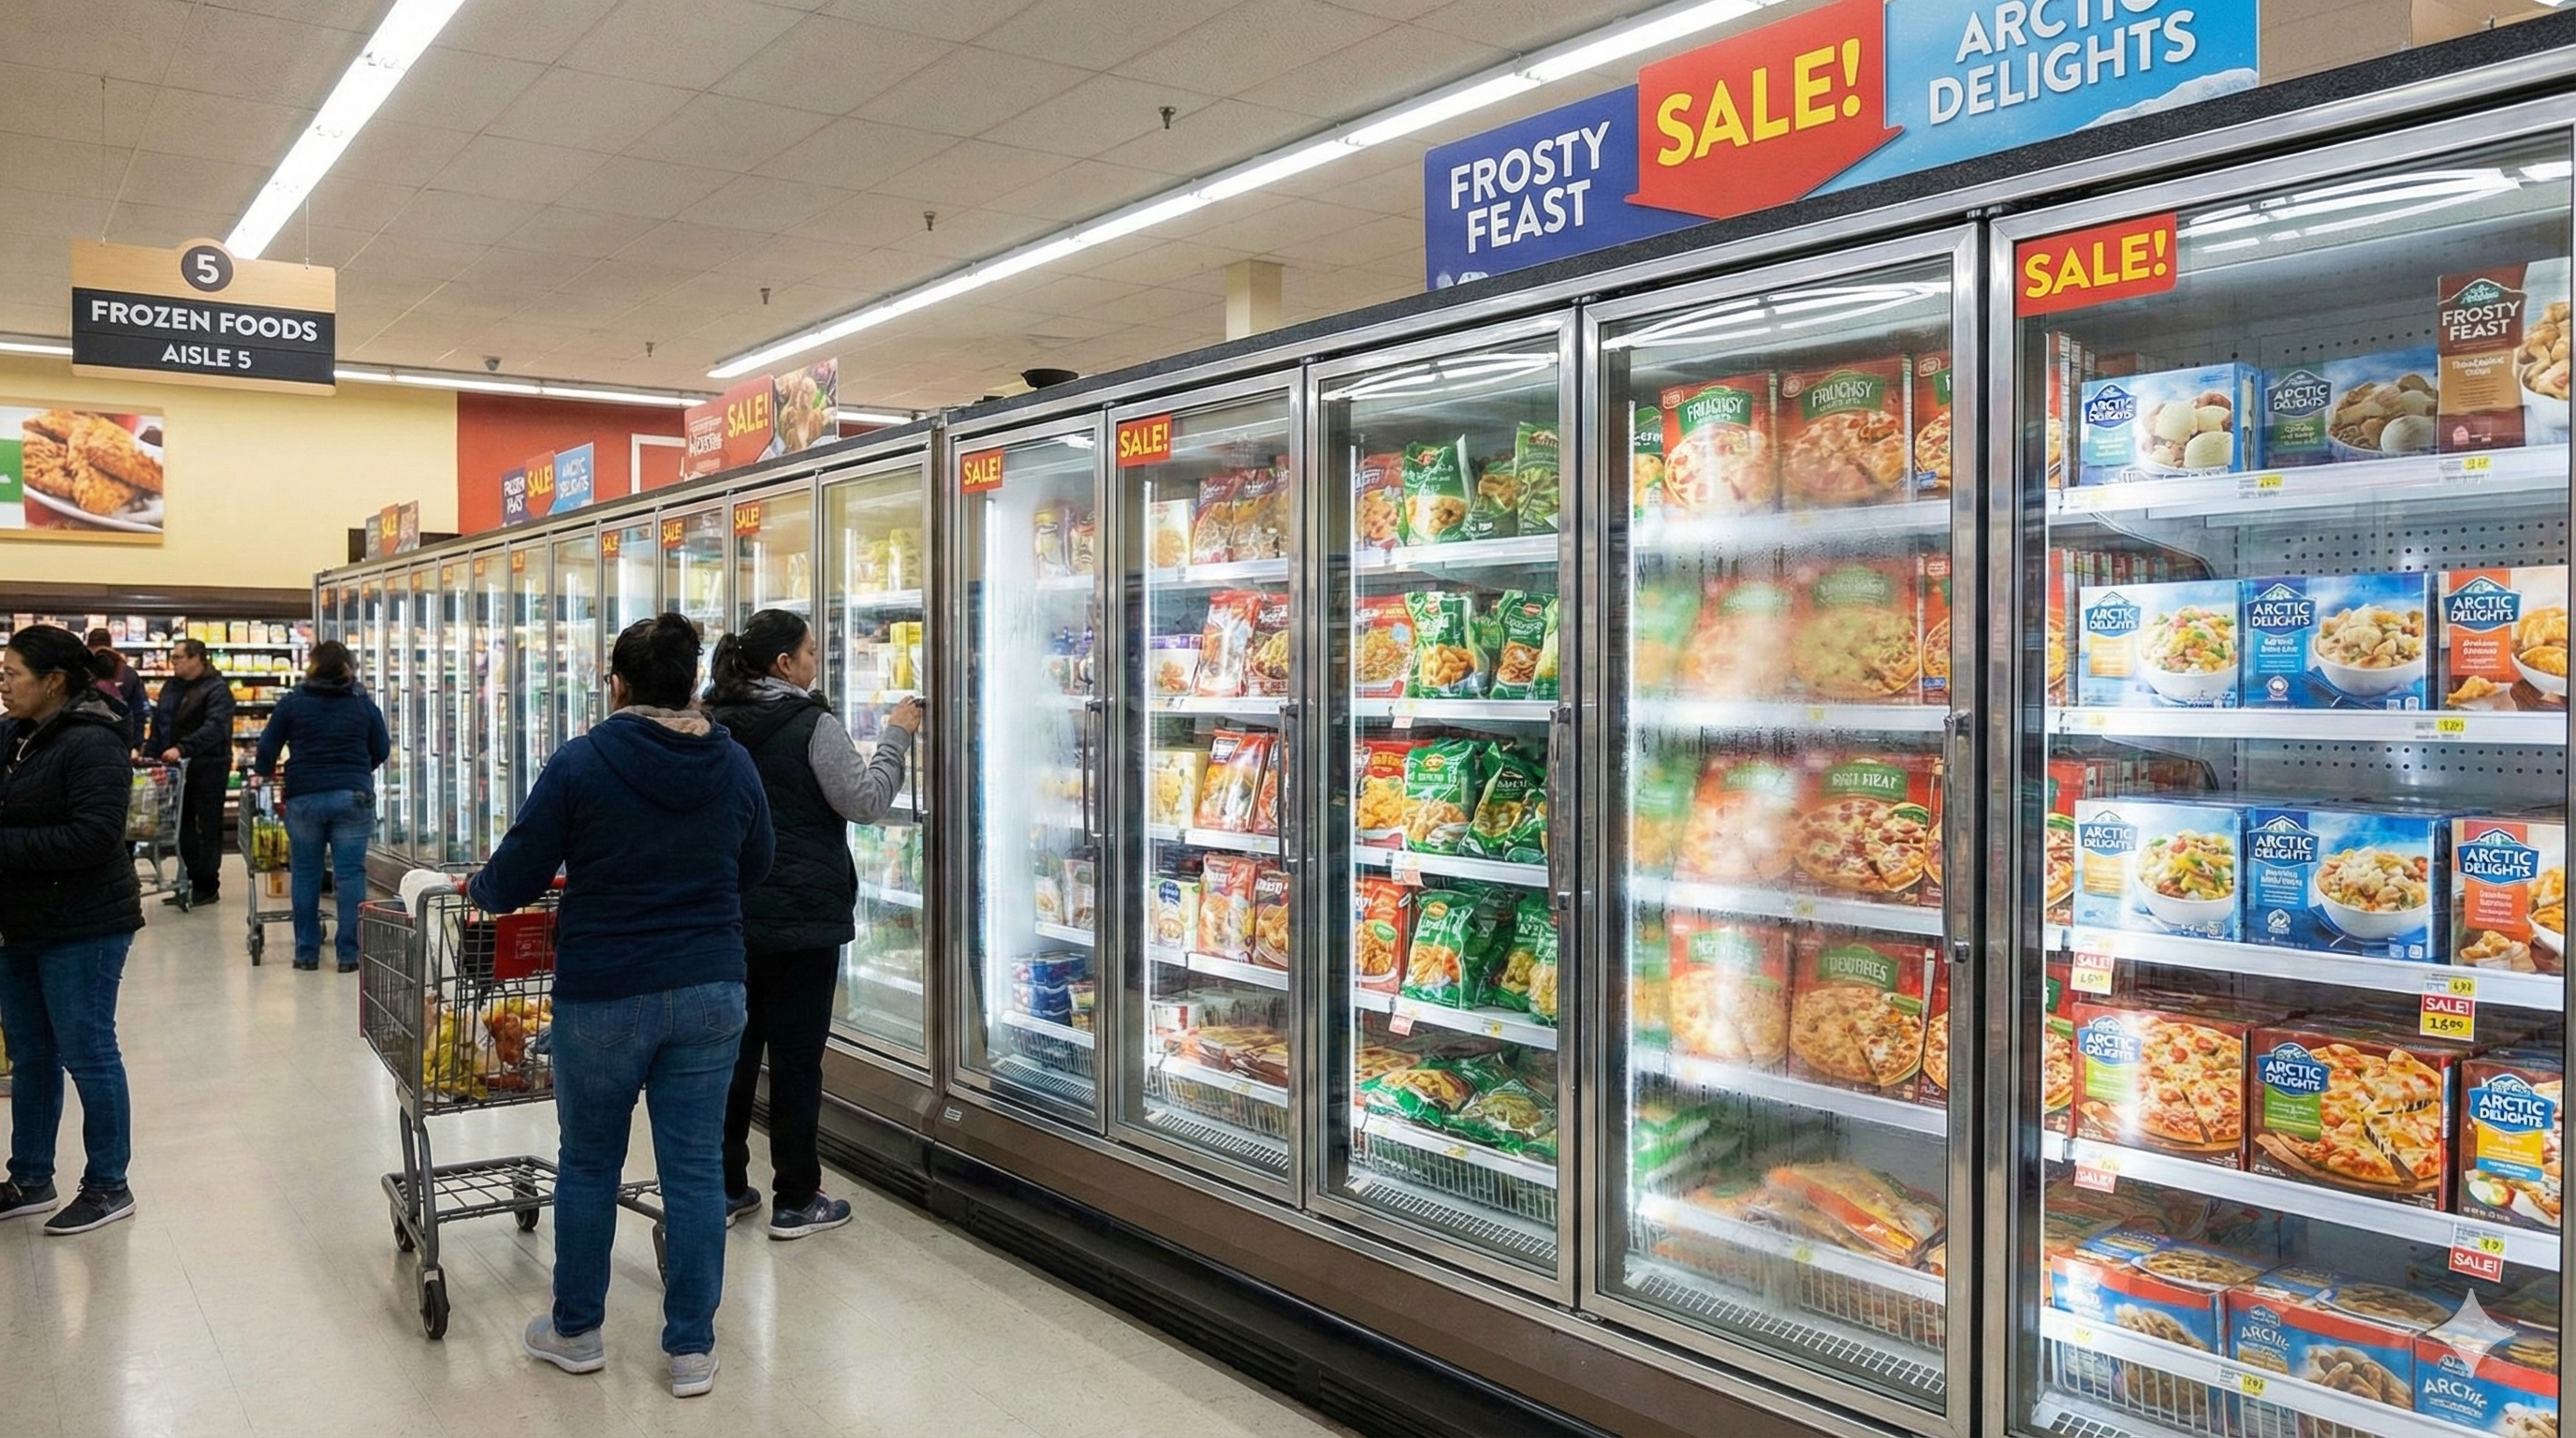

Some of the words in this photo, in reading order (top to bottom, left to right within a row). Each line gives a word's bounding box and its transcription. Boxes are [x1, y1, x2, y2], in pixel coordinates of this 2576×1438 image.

[1955, 0, 2154, 63] ARCT
[1929, 10, 2197, 125] DELIGHTS
[1656, 38, 1862, 168] SALE!
[1450, 121, 1611, 212] FROSTY
[1466, 182, 1591, 255] FEAST
[196, 254, 220, 285] 5
[2024, 230, 2169, 299] SALE!
[91, 299, 212, 333] FROZEN
[219, 312, 318, 342] FOODS
[2441, 301, 2521, 327] FROSTY
[2450, 318, 2510, 341] FEAST
[161, 344, 231, 369] AISLE
[237, 350, 253, 370] 5
[727, 391, 769, 438] SALE!
[1120, 422, 1169, 459] SALE!
[527, 463, 554, 498] SALE!
[964, 455, 1002, 486] SALE!
[2253, 601, 2310, 616] ARCTIC
[2452, 595, 2512, 610] ARCTIC
[2256, 834, 2313, 850] ARCTIC
[2465, 861, 2531, 877] DELIGHTS
[2466, 847, 2532, 866] ARCTIC
[2425, 997, 2469, 1015] SALE!
[2265, 1060, 2321, 1080] ARCTIC
[2479, 1093, 2545, 1116] ARCTIC
[2453, 1252, 2497, 1274] SALE!
